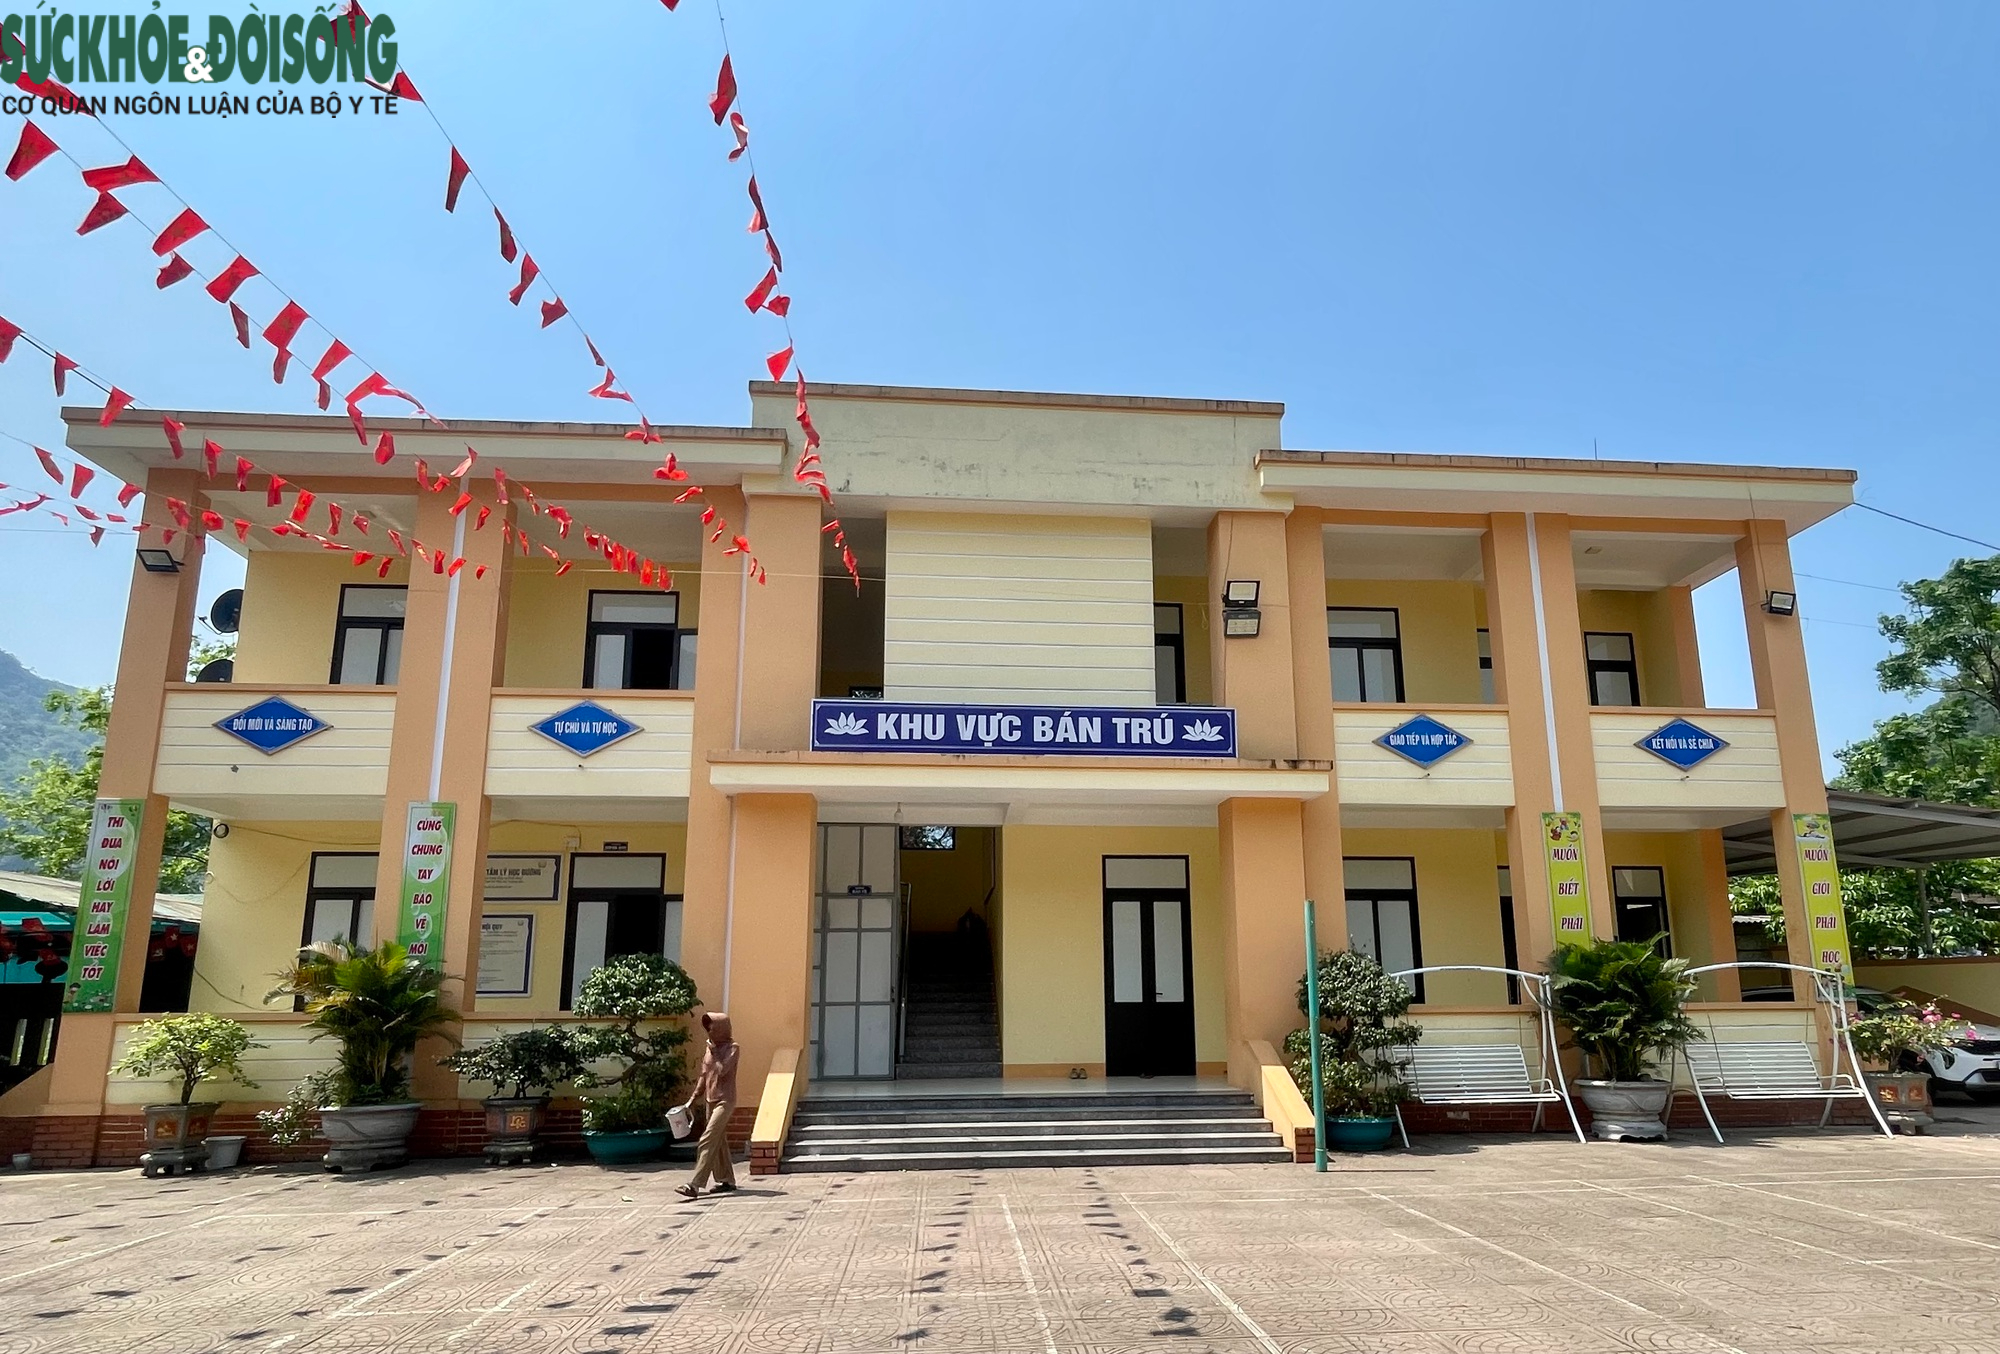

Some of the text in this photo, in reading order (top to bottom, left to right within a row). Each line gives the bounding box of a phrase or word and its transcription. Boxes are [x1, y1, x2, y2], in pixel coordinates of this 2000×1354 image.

[232, 714, 313, 733] ĐỔI MỚI VÀ SÁNG TẠO
[554, 718, 618, 736] TỰ CHỦ VÀ TỰ HỌC
[876, 711, 1174, 747] KHU VỰC BÁN TRÚ
[1389, 731, 1458, 748] GIAO TIẾP VÀ HỢP TÁC
[1651, 735, 1715, 750] KẾT NỐI VÀ SẺ CHIA
[107, 816, 125, 828] THI
[416, 817, 442, 832] CÙNG
[100, 837, 122, 849] ĐUA
[411, 844, 443, 856] CHUNG
[1552, 843, 1579, 861] MUỐN
[1803, 844, 1829, 861] MUỐN
[98, 856, 120, 870] NÓI
[417, 868, 434, 880] TAY
[95, 876, 116, 891] LỜI
[1558, 877, 1580, 895] BIẾT
[412, 889, 433, 905] BẢO
[91, 901, 114, 913] HAY
[1561, 913, 1584, 930] PHẢI
[1815, 913, 1837, 929] PHẢI
[408, 940, 428, 955] MÔI
